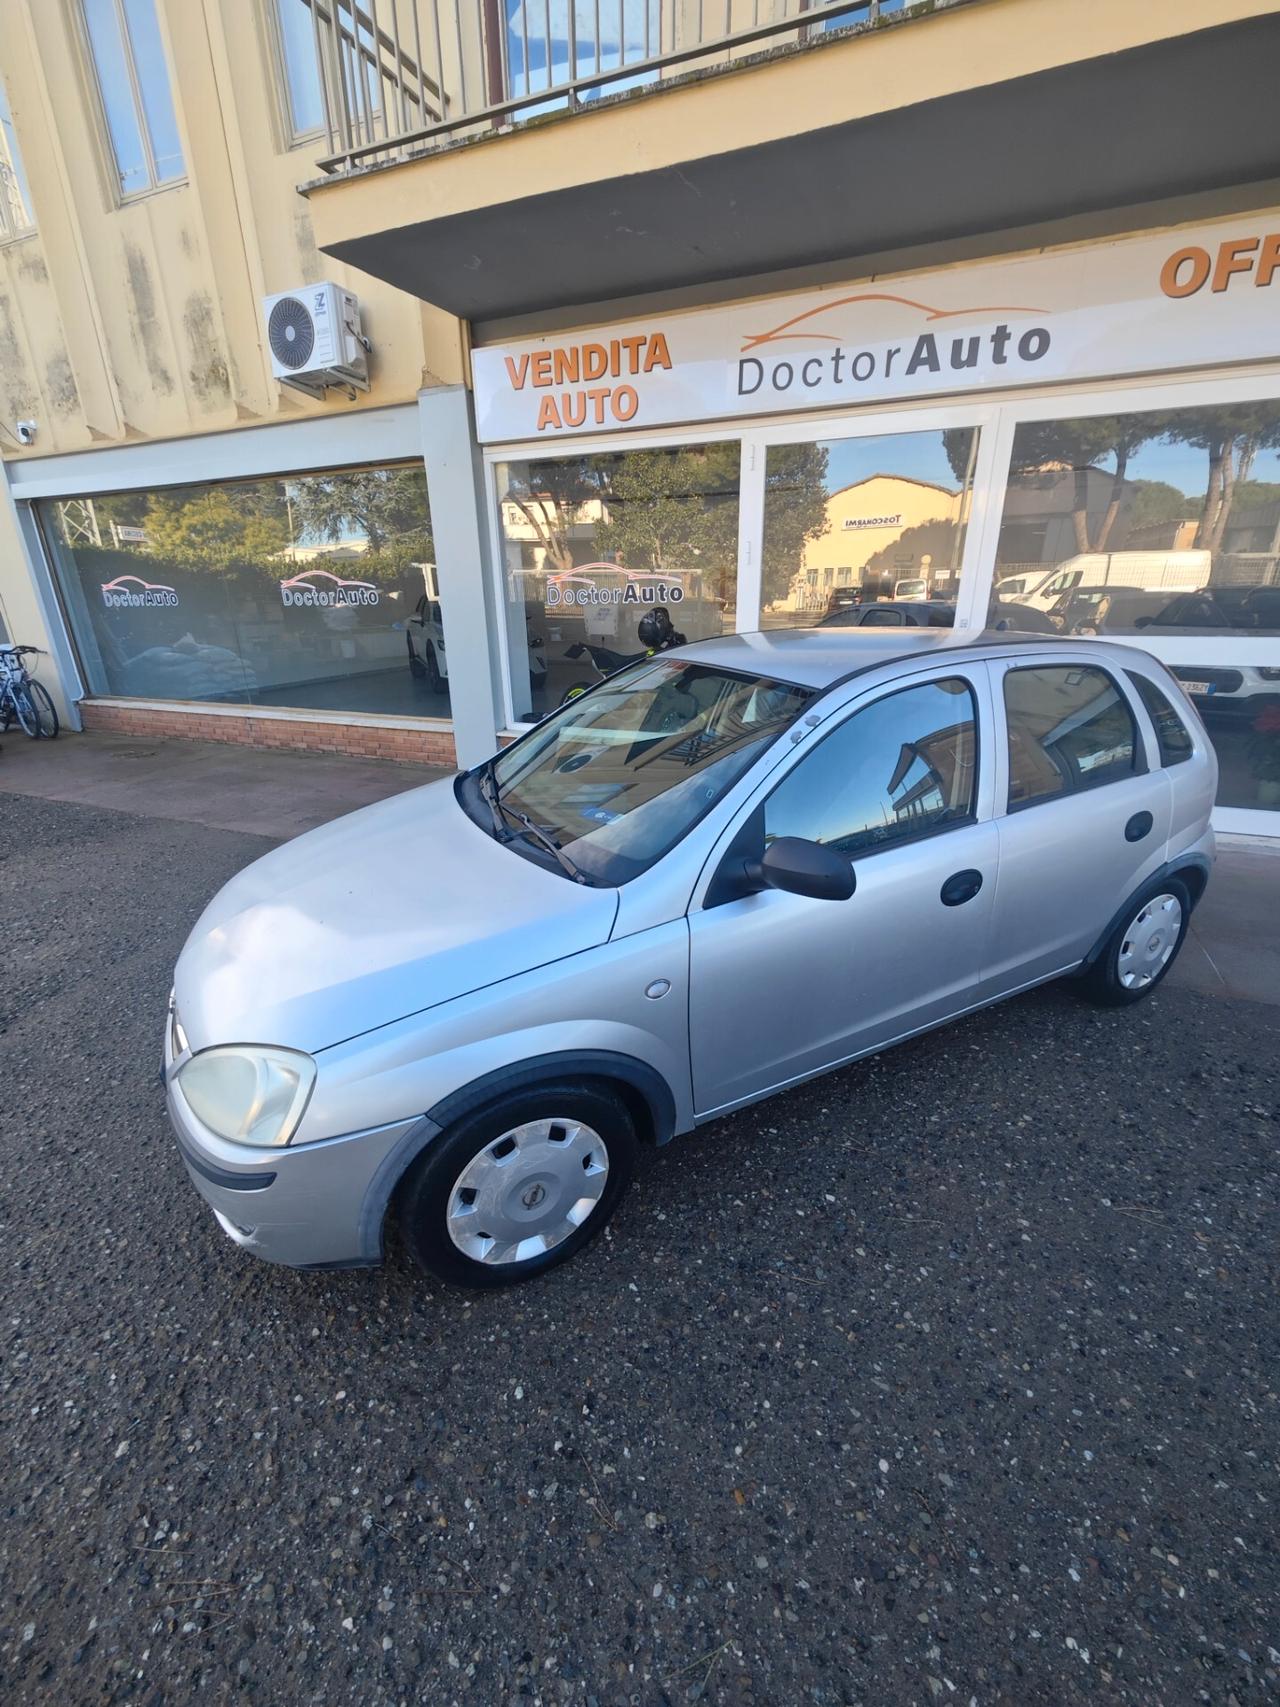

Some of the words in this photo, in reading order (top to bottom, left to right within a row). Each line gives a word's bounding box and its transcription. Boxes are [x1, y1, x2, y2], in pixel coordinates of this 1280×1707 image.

[504, 332, 672, 390] VENDITA
[738, 323, 1052, 396] DoctorAuto
[537, 384, 639, 430] AUTO
[102, 590, 179, 607] DoctorAuto
[281, 587, 379, 606] DoctorAuto
[547, 582, 684, 606] DoctorAuto
